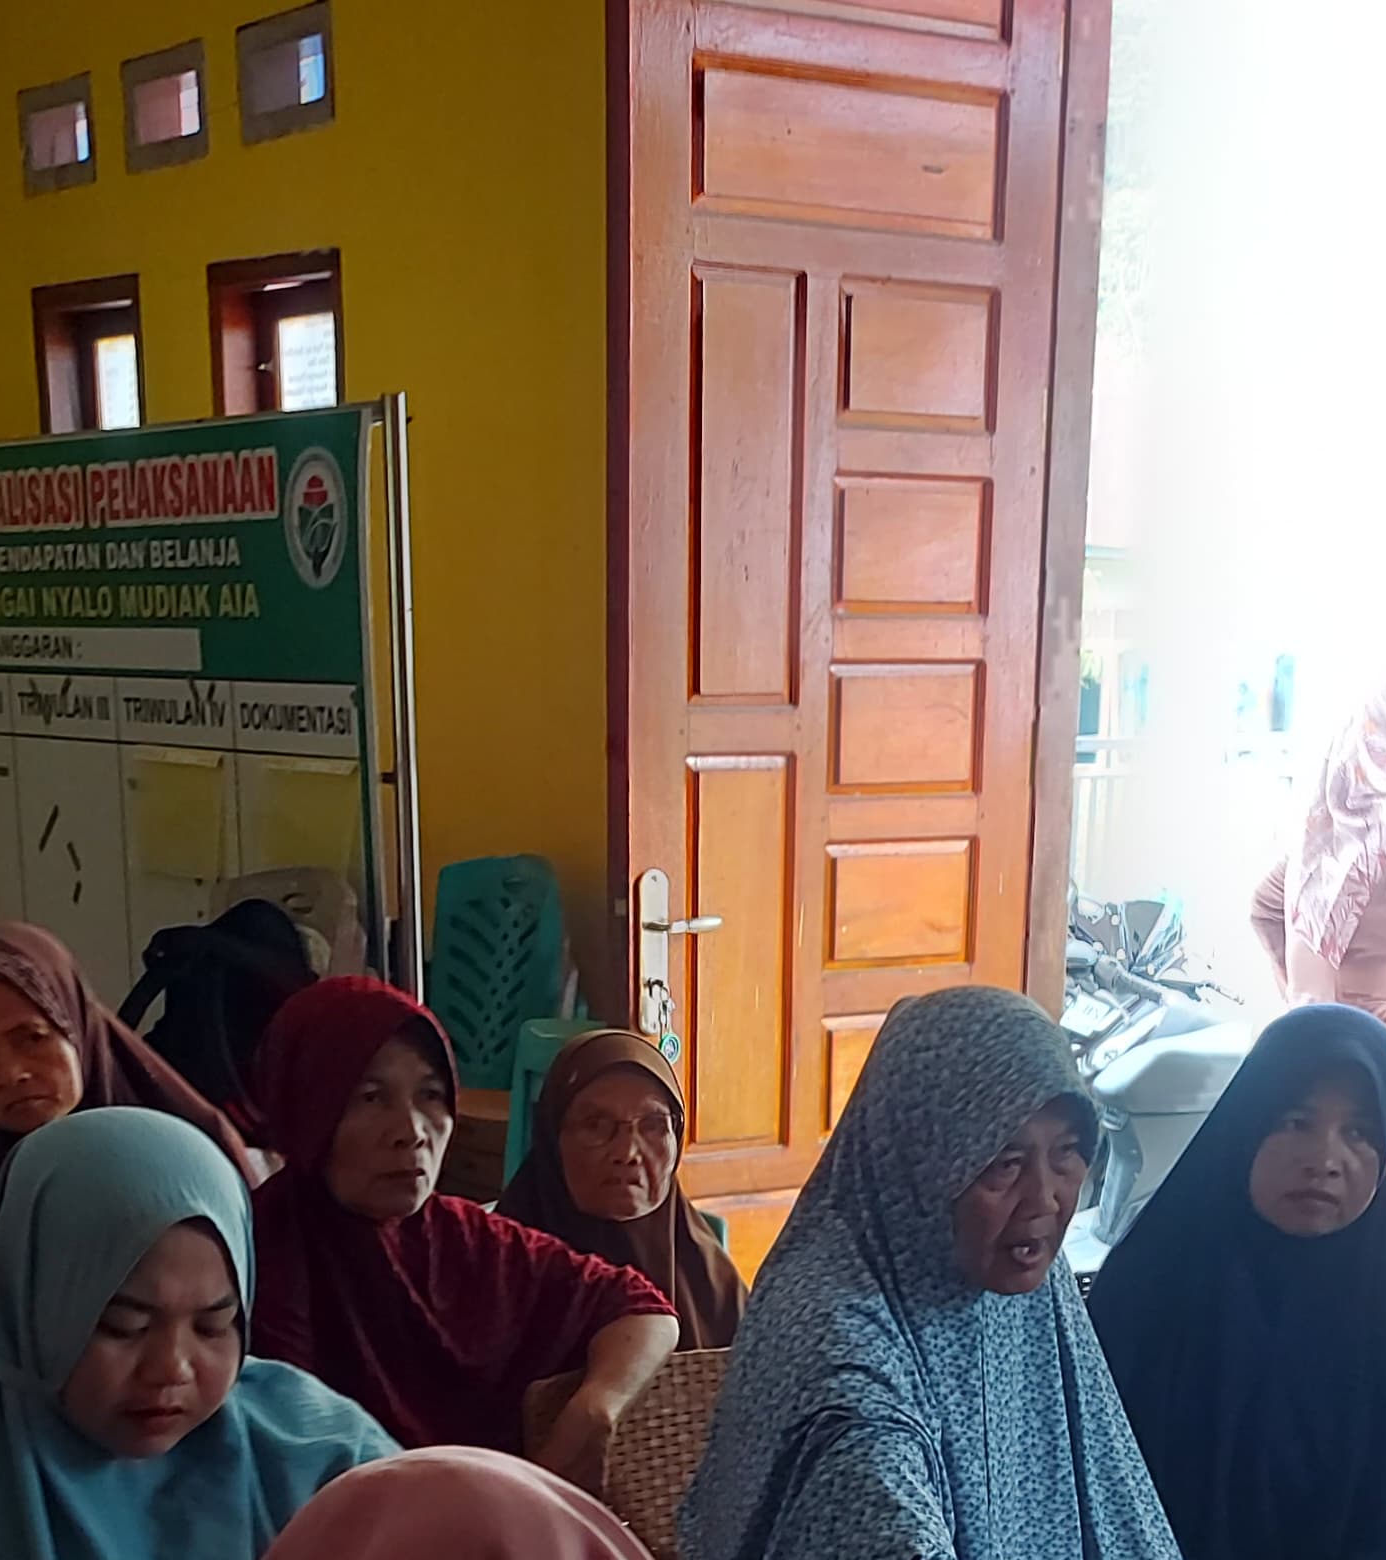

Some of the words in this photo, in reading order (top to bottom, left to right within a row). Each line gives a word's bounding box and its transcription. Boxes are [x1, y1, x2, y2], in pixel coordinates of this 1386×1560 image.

[87, 447, 278, 529] PELAKSANAAN
[105, 539, 145, 569] DAN
[150, 536, 241, 568] BELANJA
[41, 585, 113, 619] NYALO
[119, 583, 212, 618] MUDIAK
[218, 582, 261, 618] AIA
[123, 697, 205, 727] TRIWULAN
[239, 702, 352, 735] DOKUMENTASI
